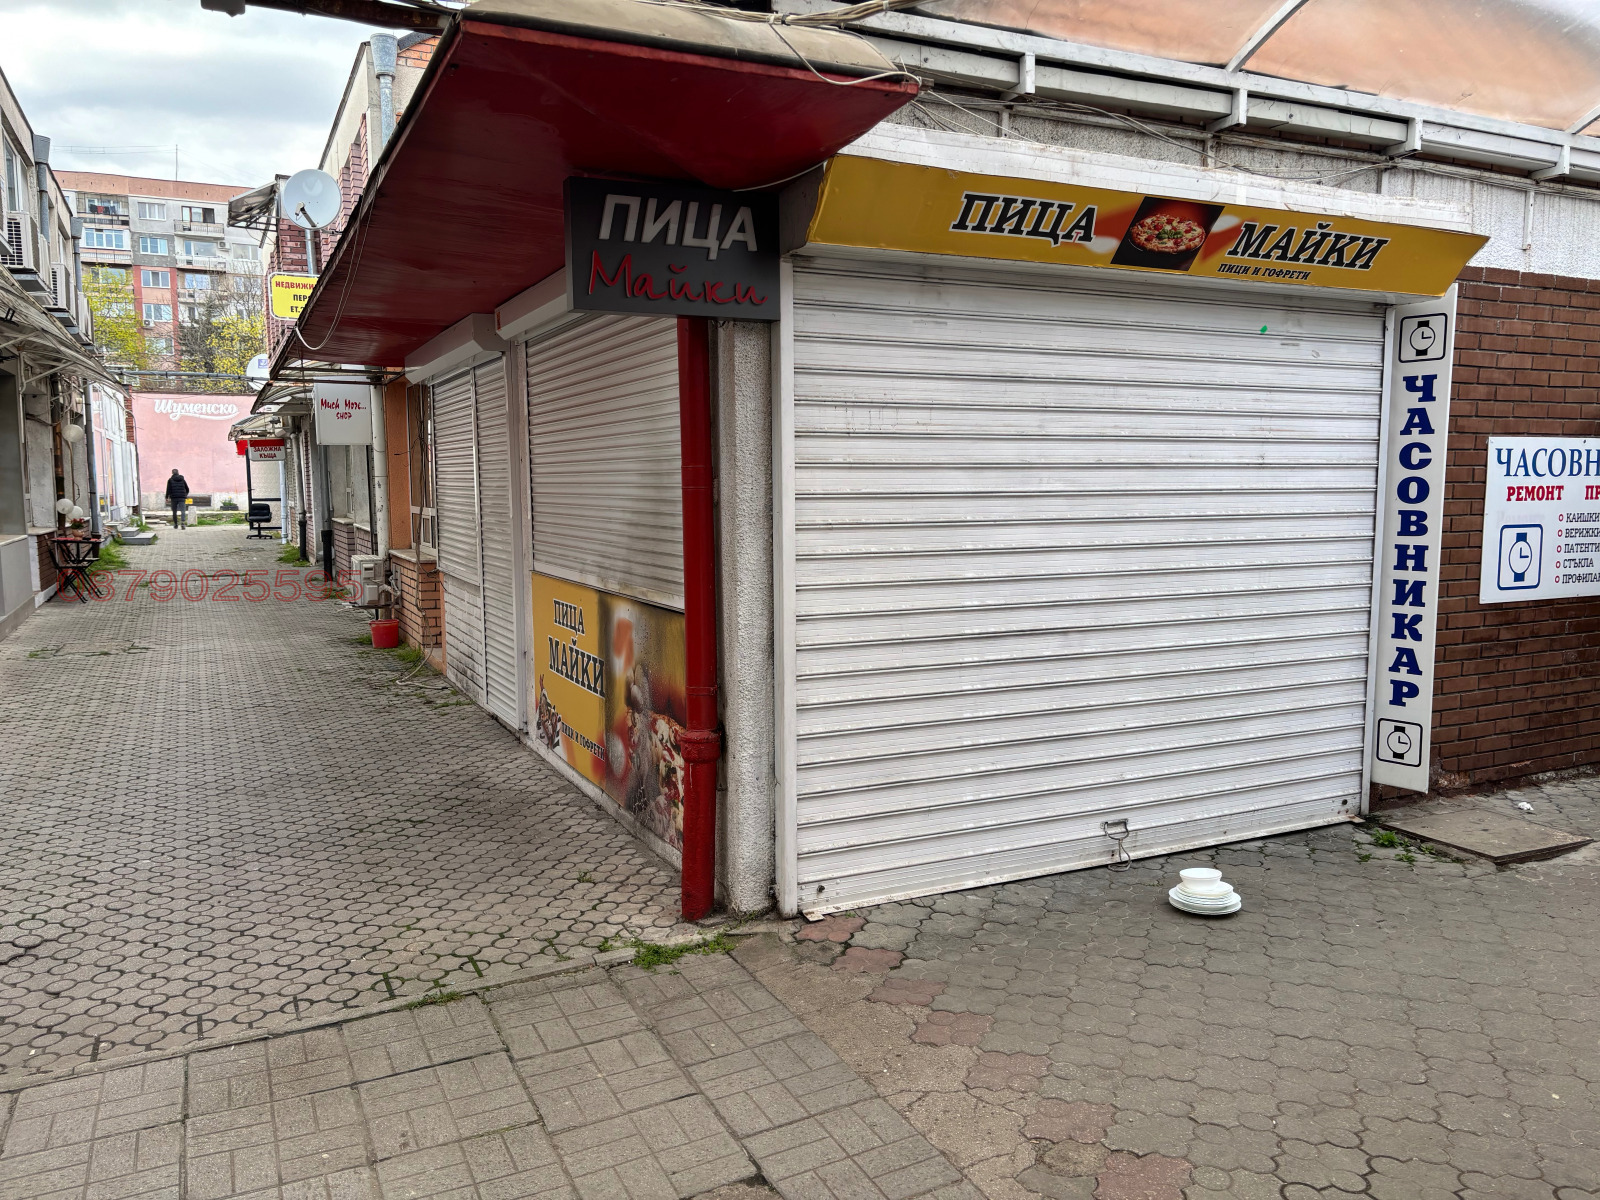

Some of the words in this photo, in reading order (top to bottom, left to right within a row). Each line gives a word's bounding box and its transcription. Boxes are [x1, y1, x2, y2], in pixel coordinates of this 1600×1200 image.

[599, 194, 758, 260] ПИЦА
[950, 191, 1098, 247] ПИЦА
[1225, 221, 1391, 271] МАЙКИ
[588, 249, 769, 305] Майки
[1217, 263, 1251, 276] ПИЦИ
[1252, 267, 1262, 276] И
[1262, 268, 1312, 280] ГОФРЕТИ
[154, 400, 240, 421] Шуменско
[320, 398, 340, 411] Much
[336, 411, 352, 420] SHOP
[1495, 448, 1600, 478] ЧАСОВН
[1506, 485, 1565, 502] РЕМОНТ
[1389, 374, 1439, 707] ЧАСОВНИКАР
[1562, 558, 1594, 569] СТЪКЛА
[553, 598, 585, 637] ПИЦА
[548, 635, 606, 699] МАЙКИ
[574, 730, 580, 744] И
[580, 733, 606, 762] ГОФРЕТИ
